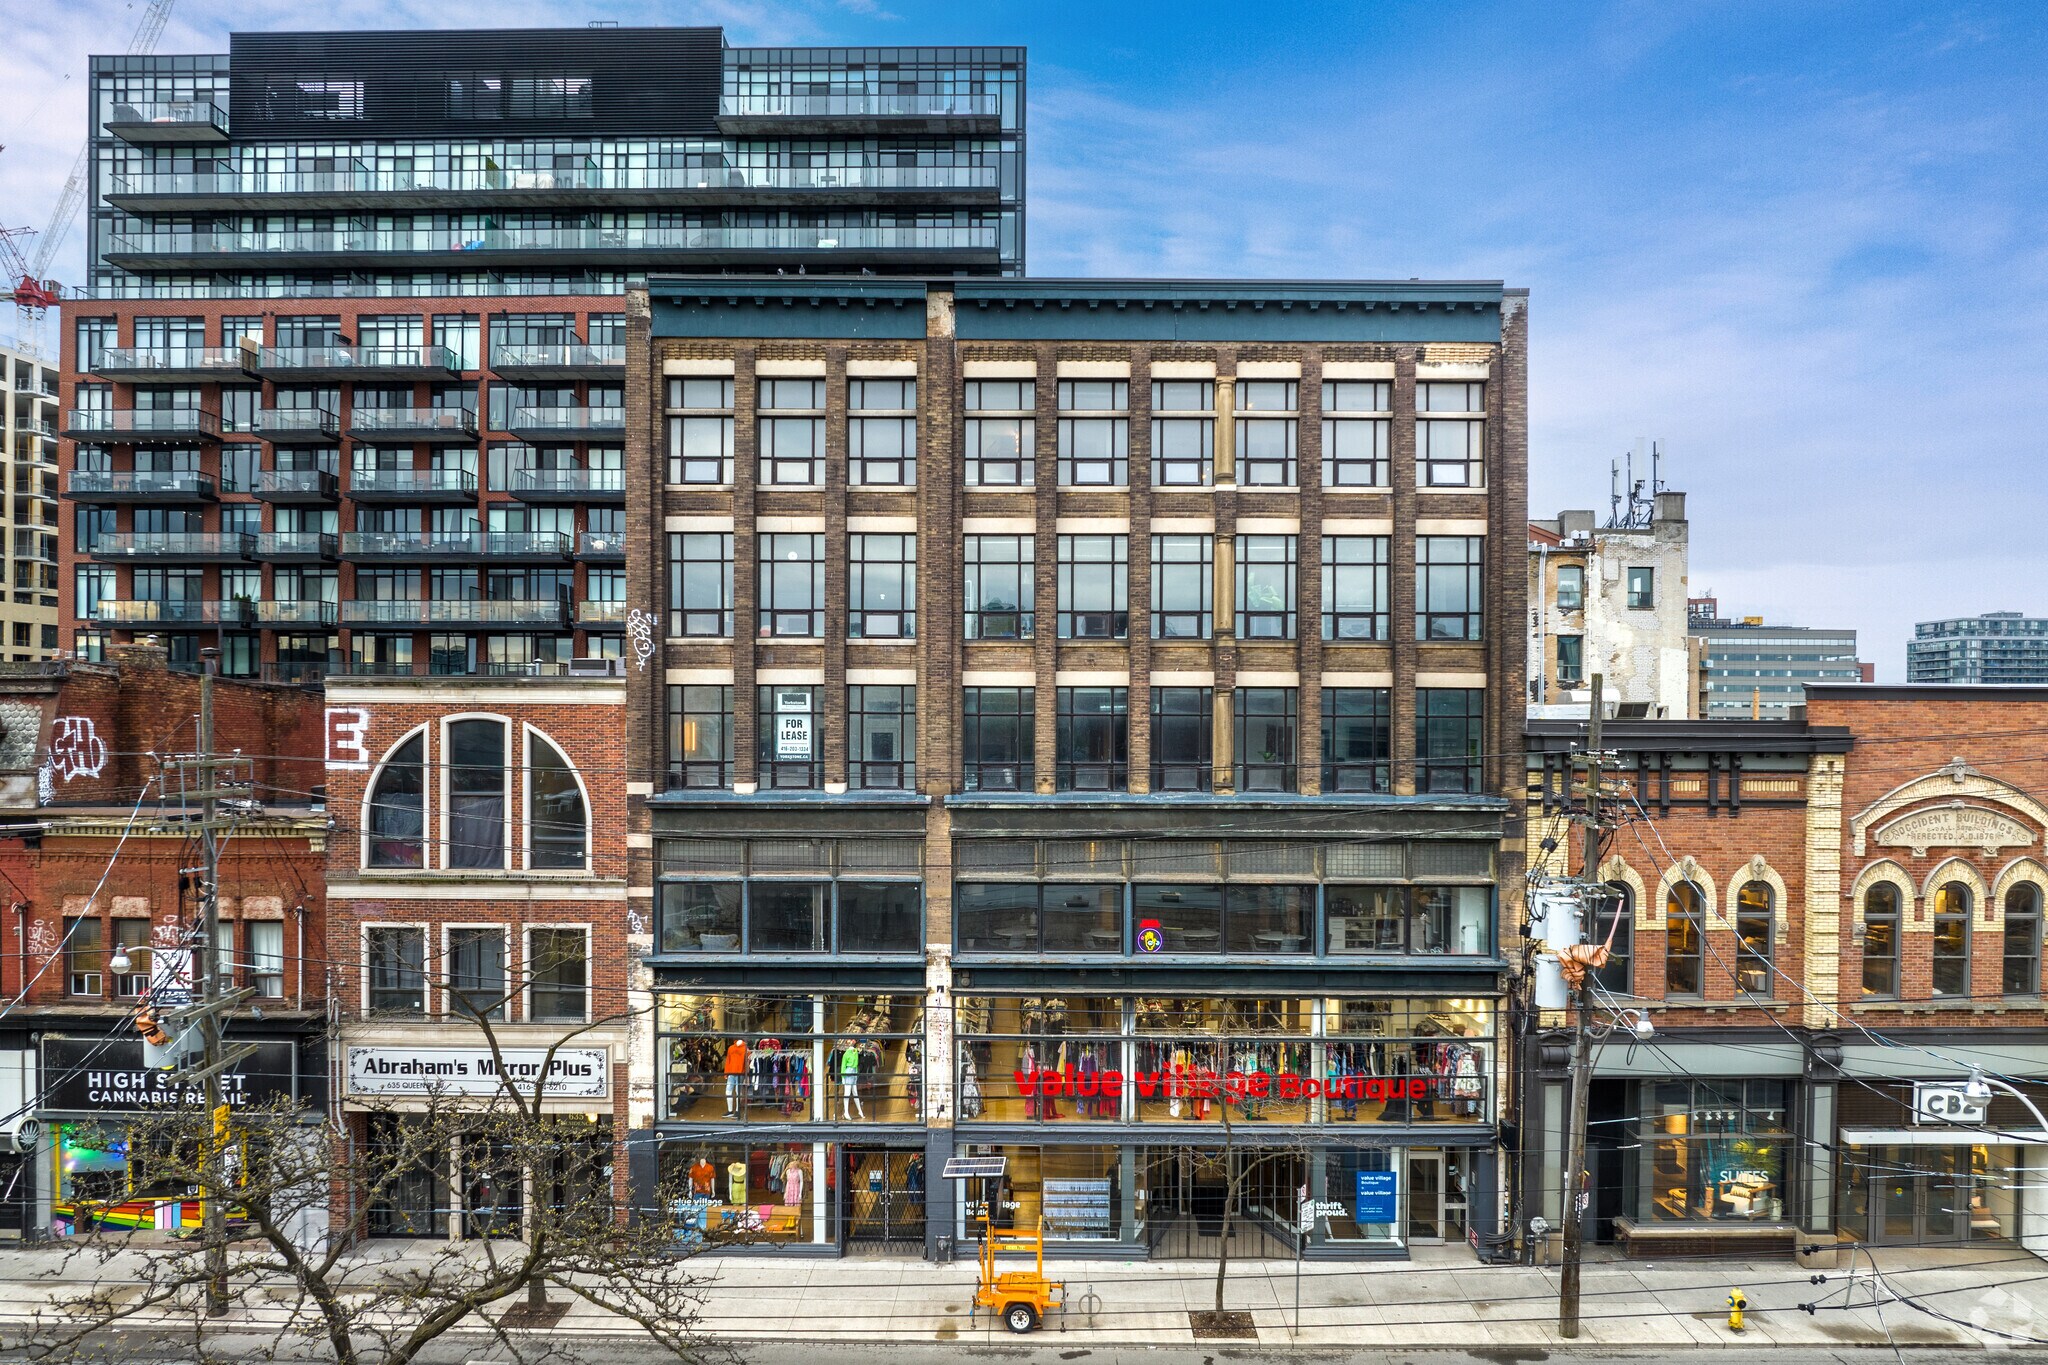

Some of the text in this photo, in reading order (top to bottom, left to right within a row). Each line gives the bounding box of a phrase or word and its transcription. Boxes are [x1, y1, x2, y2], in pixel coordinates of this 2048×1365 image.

[785, 719, 803, 728] FOR
[781, 731, 808, 740] LEASE
[1900, 813, 2013, 835] OCCIDENT BUILDINGS
[363, 1058, 468, 1075] Abraham's
[550, 1060, 592, 1076] Plus
[88, 1072, 146, 1089] HIGH
[1013, 1063, 1124, 1097] value
[1279, 1072, 1427, 1103] Boutique
[88, 1091, 178, 1104] CANNABIS
[1720, 1171, 1769, 1183] SUITES
[1315, 1201, 1342, 1210] thrift
[1316, 1208, 1348, 1218] proud.
